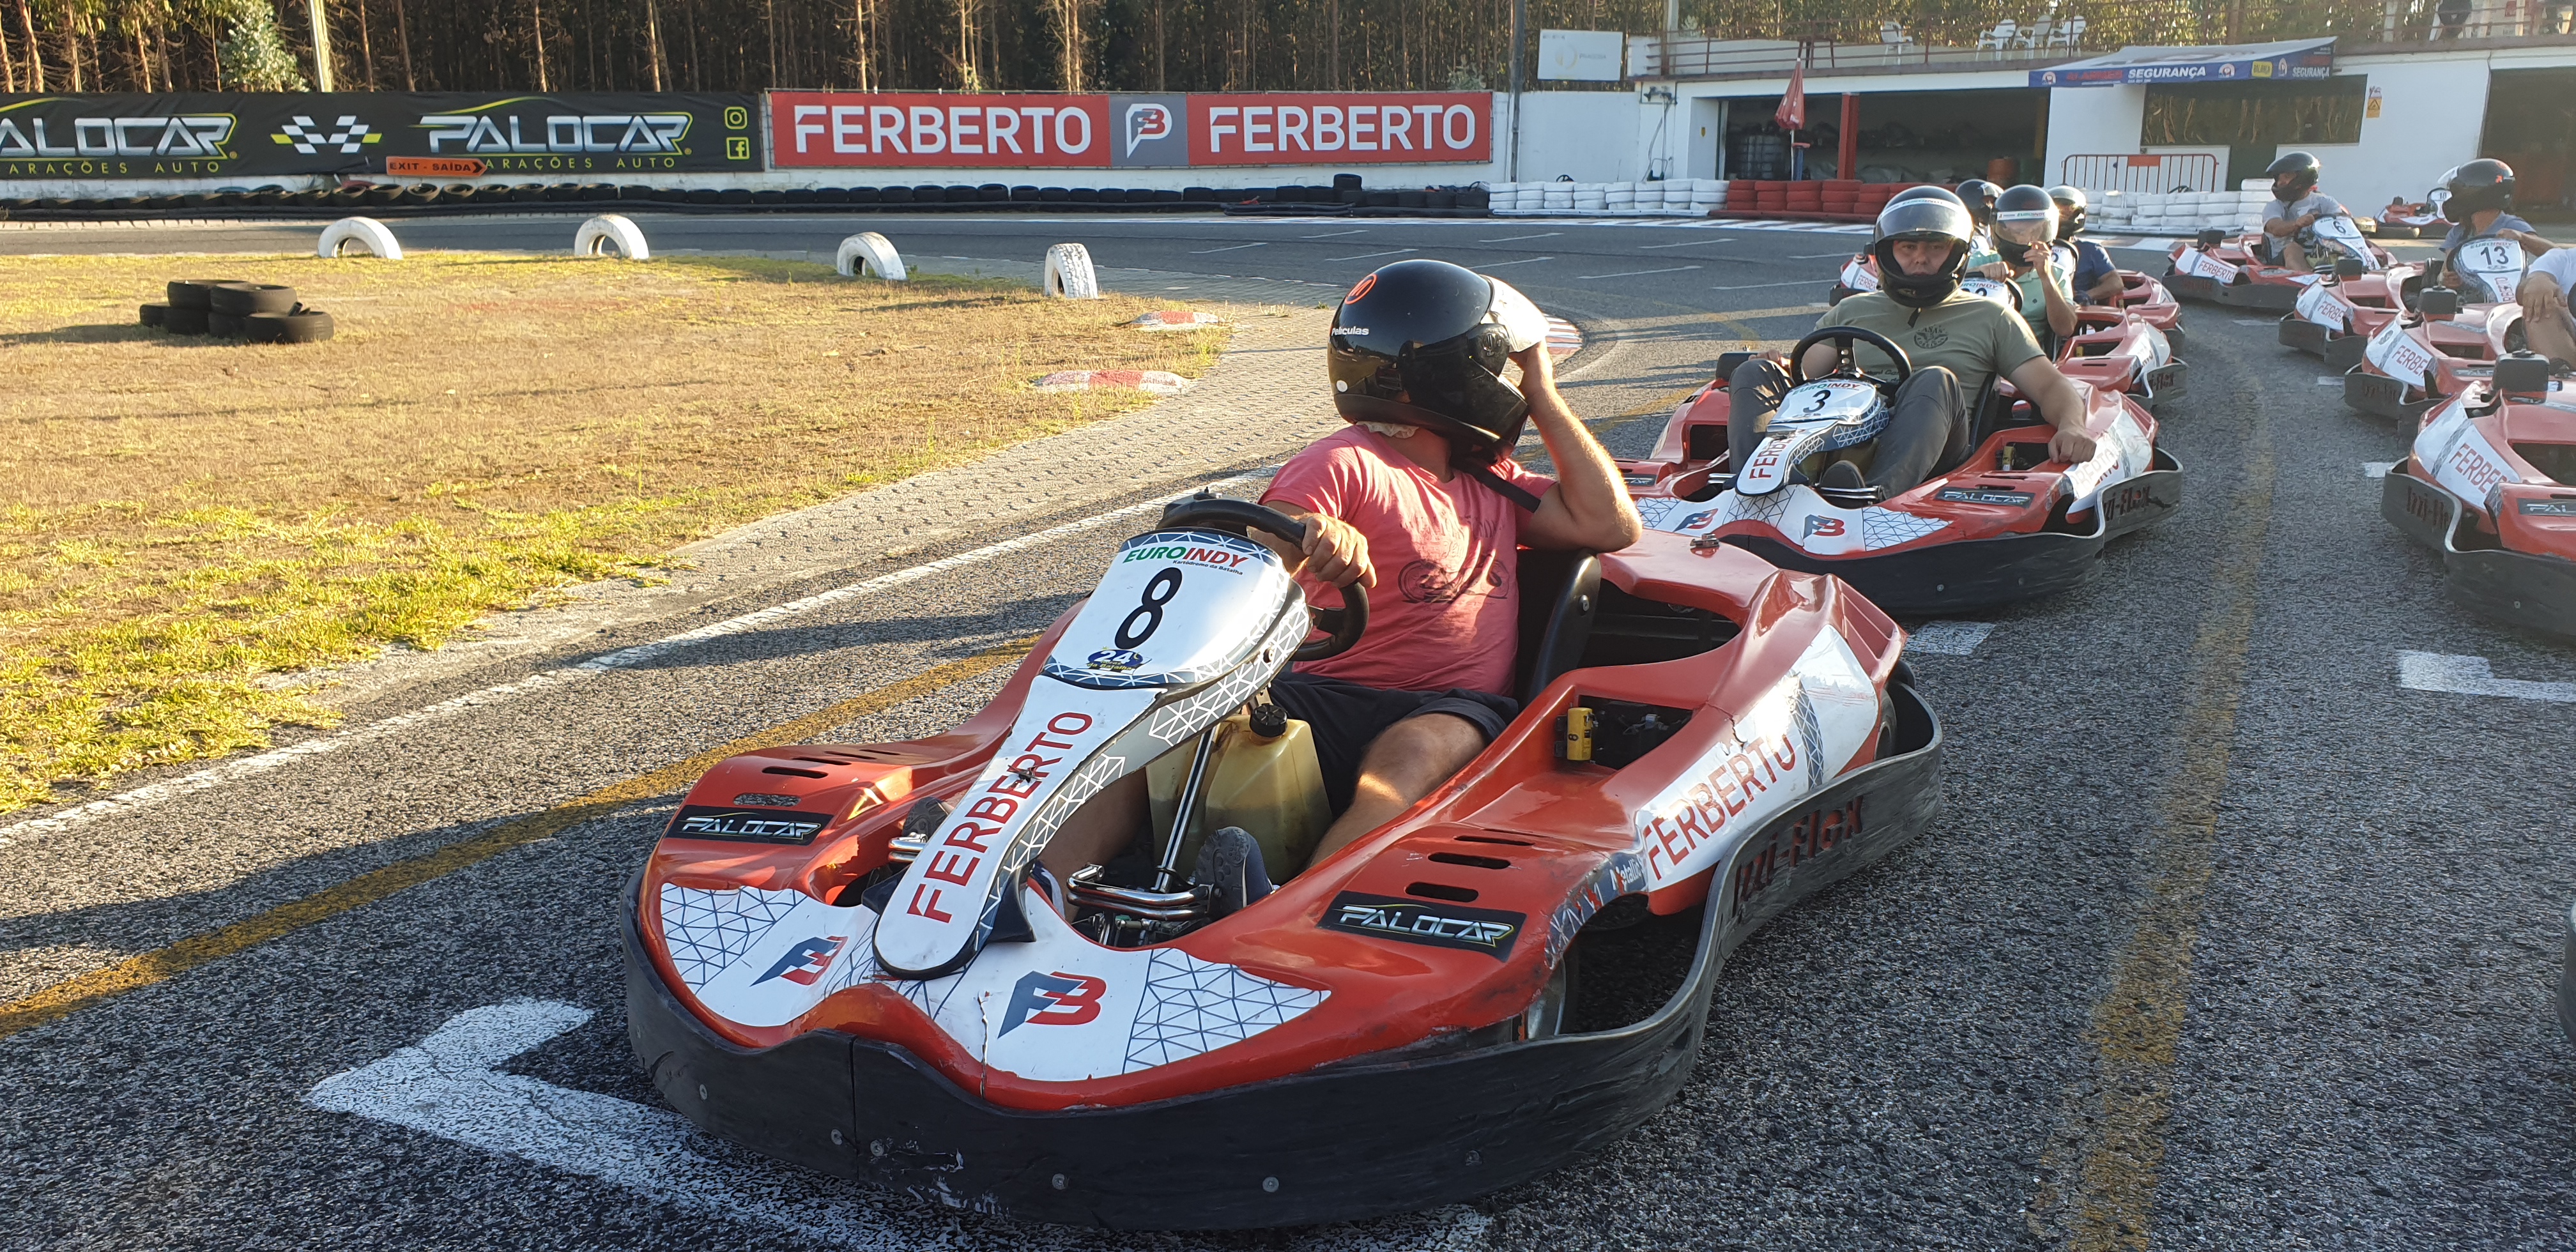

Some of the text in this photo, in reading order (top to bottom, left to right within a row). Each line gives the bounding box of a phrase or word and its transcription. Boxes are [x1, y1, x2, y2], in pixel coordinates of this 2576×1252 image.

[2128, 66, 2206, 79] SEGURANÇA
[2292, 66, 2330, 80] SEGURANÇA
[419, 115, 689, 153] PALOCAR
[793, 104, 1092, 154] FERBERTO
[1209, 103, 1476, 153] FERBERTO
[155, 161, 220, 173] AUTO
[389, 162, 418, 171] EXIT
[432, 160, 471, 172] SAÍDA
[617, 156, 675, 169] AUTO
[2333, 220, 2347, 235] 6
[2480, 246, 2509, 266] 13
[2198, 260, 2235, 281] FERBERTO
[1792, 382, 1861, 396] EUROINDY
[1802, 389, 1831, 414] 3
[1943, 491, 2030, 504] PALOCAR
[1123, 546, 1249, 567] EUROINDY
[1218, 565, 1243, 575] Batalha
[1114, 567, 1183, 650] 8
[1093, 650, 1133, 664] 24
[1643, 732, 1796, 881] FERBERTO
[682, 817, 820, 837] PALOCAR
[907, 712, 1092, 924] FERBERTO
[1340, 905, 1511, 943] PALOCAR
